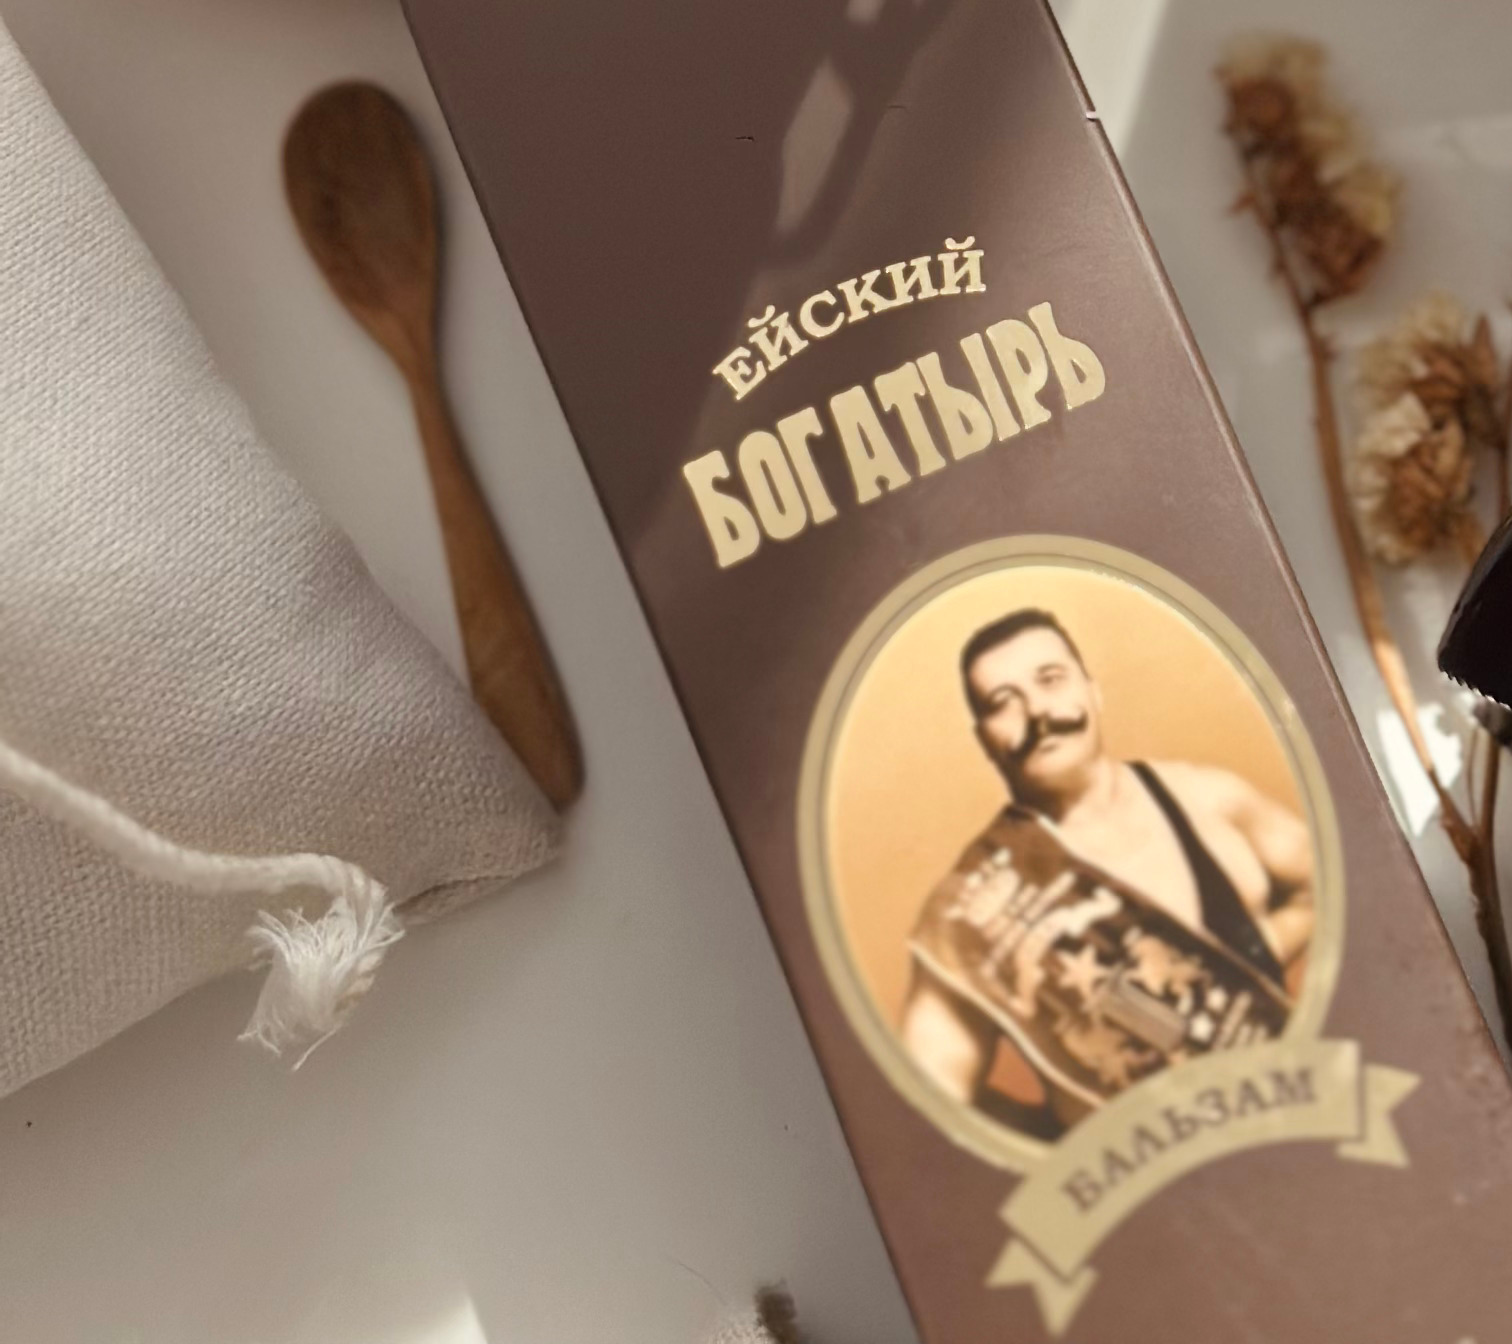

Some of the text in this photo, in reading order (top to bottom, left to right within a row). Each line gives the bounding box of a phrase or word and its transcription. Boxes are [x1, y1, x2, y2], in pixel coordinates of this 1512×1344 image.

[712, 235, 987, 401] ЕЙСКИЙ
[683, 301, 1106, 570] БОГАТЫРЬ
[1060, 1067, 1318, 1217] БАЛЬЗАМ
